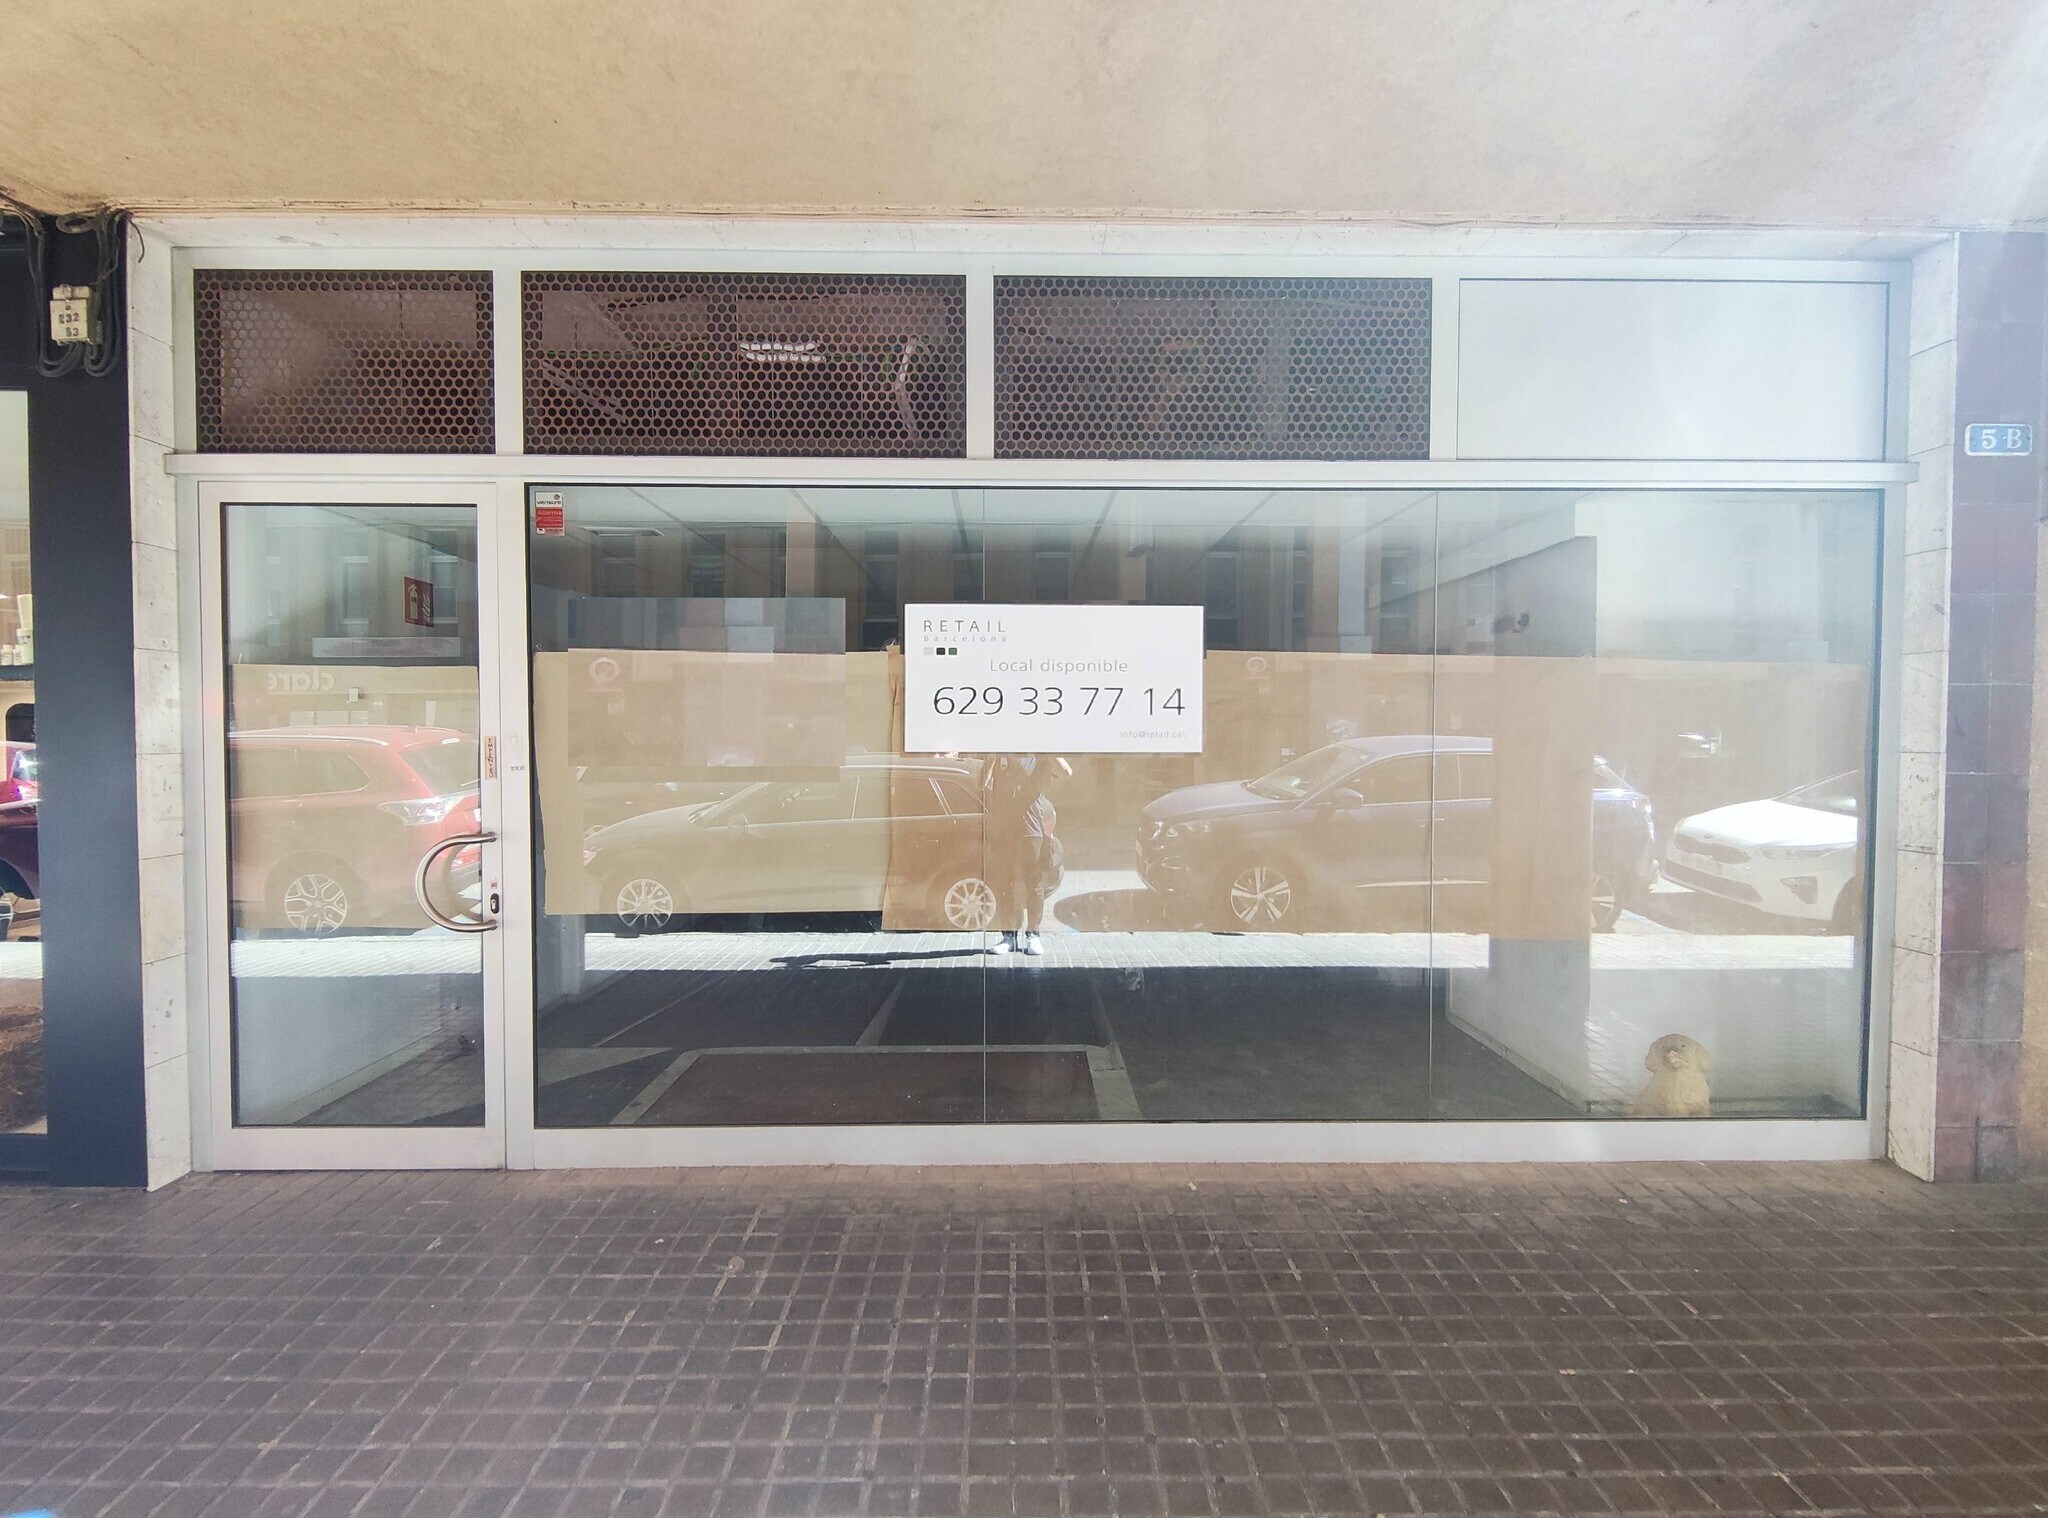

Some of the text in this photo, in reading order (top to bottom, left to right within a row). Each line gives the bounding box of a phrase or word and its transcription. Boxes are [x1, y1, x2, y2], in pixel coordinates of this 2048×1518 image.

[1981, 428, 1997, 450] 5
[923, 619, 1006, 633] RETAIL
[990, 659, 1128, 675] Local disponible
[933, 686, 1186, 716] 629 33 77 14
[1120, 730, 1187, 739] info@retail.cat
